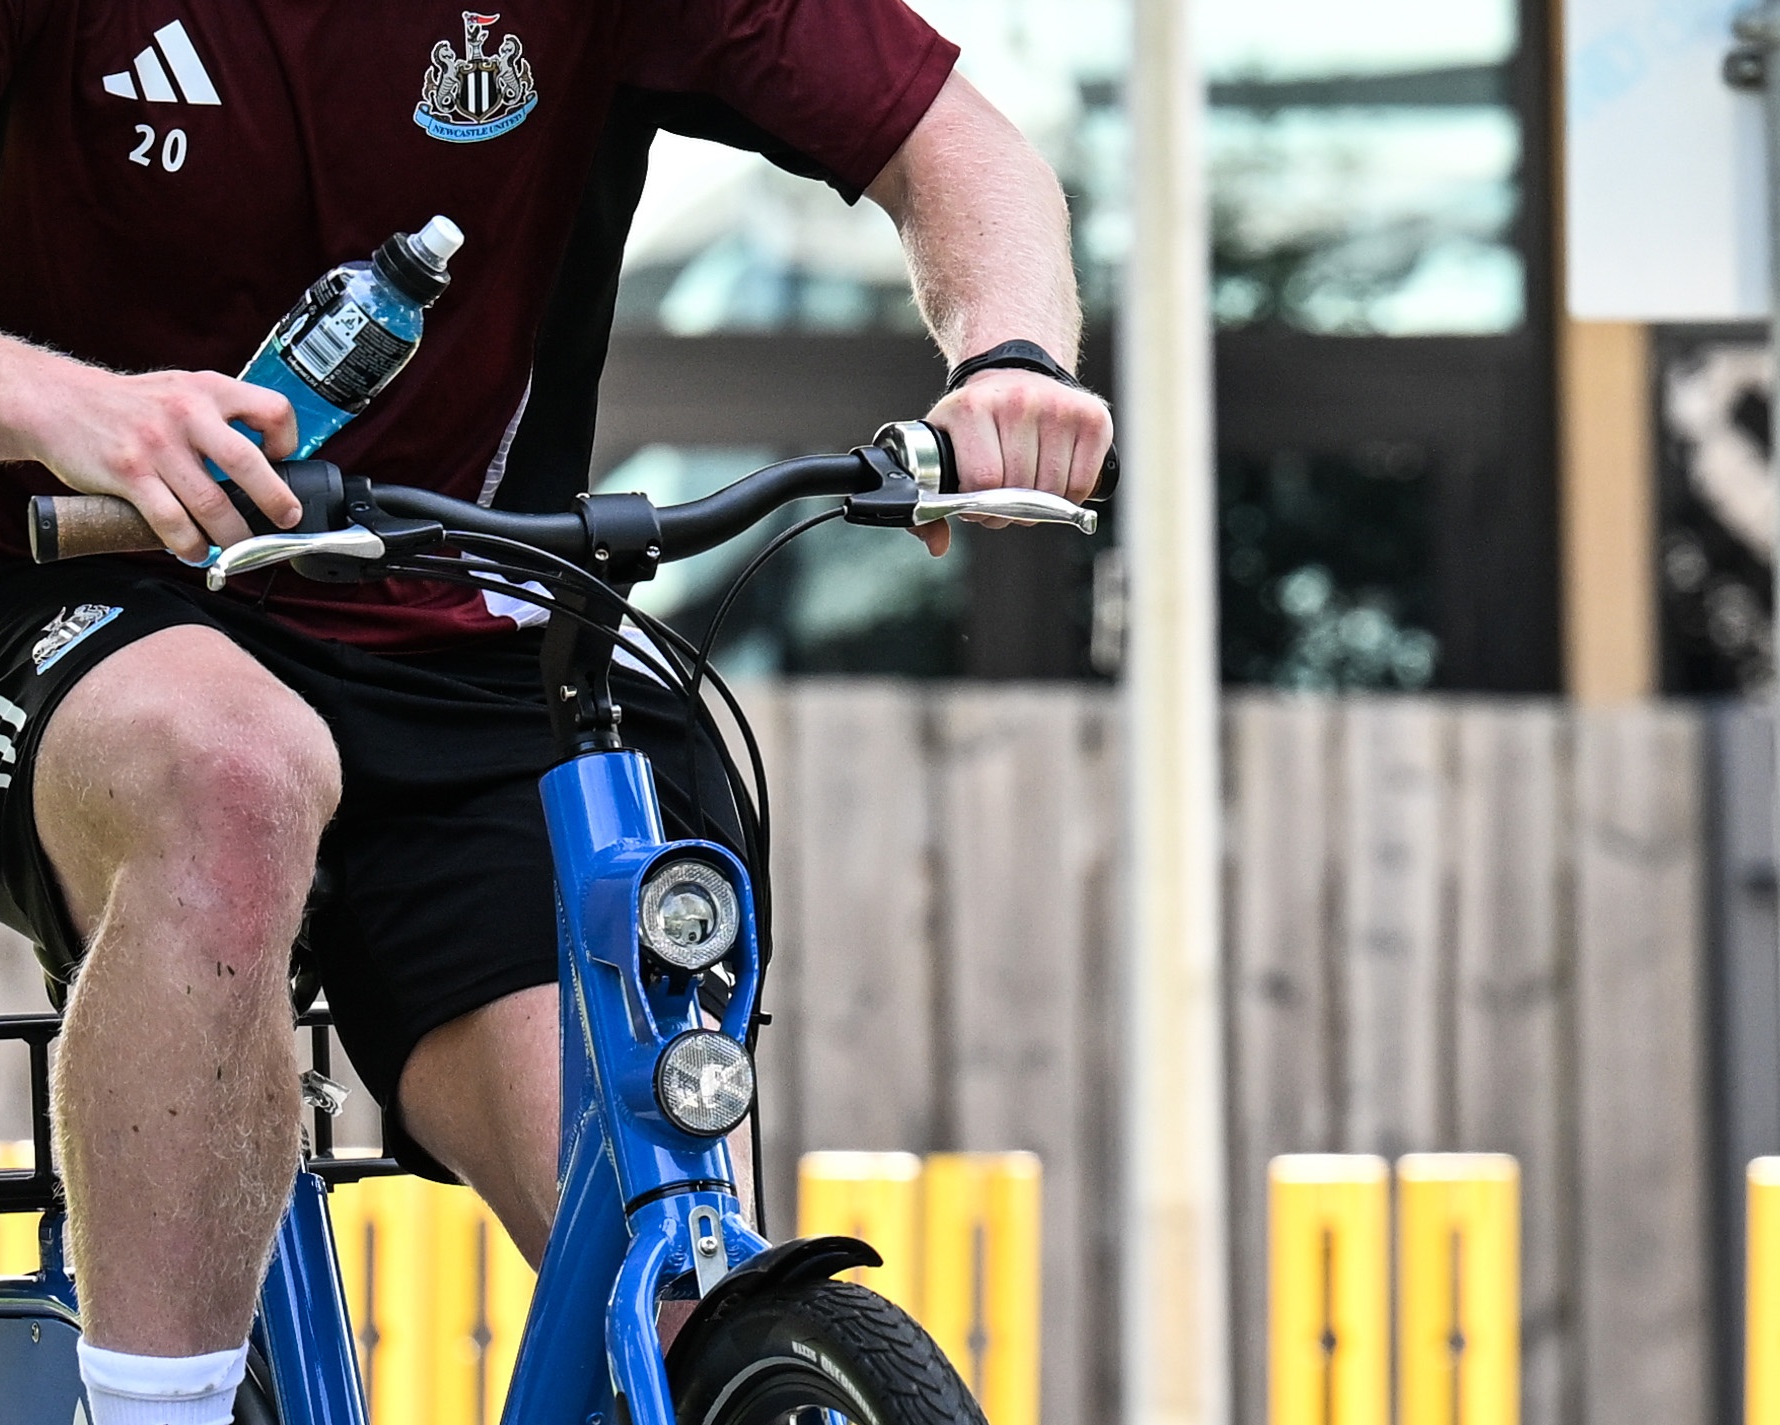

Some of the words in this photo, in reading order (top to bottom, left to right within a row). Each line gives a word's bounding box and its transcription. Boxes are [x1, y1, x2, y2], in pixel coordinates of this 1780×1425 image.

[432, 124, 488, 138] NEWCASTLE
[489, 113, 522, 133] UNITED
[128, 123, 188, 173] 20
